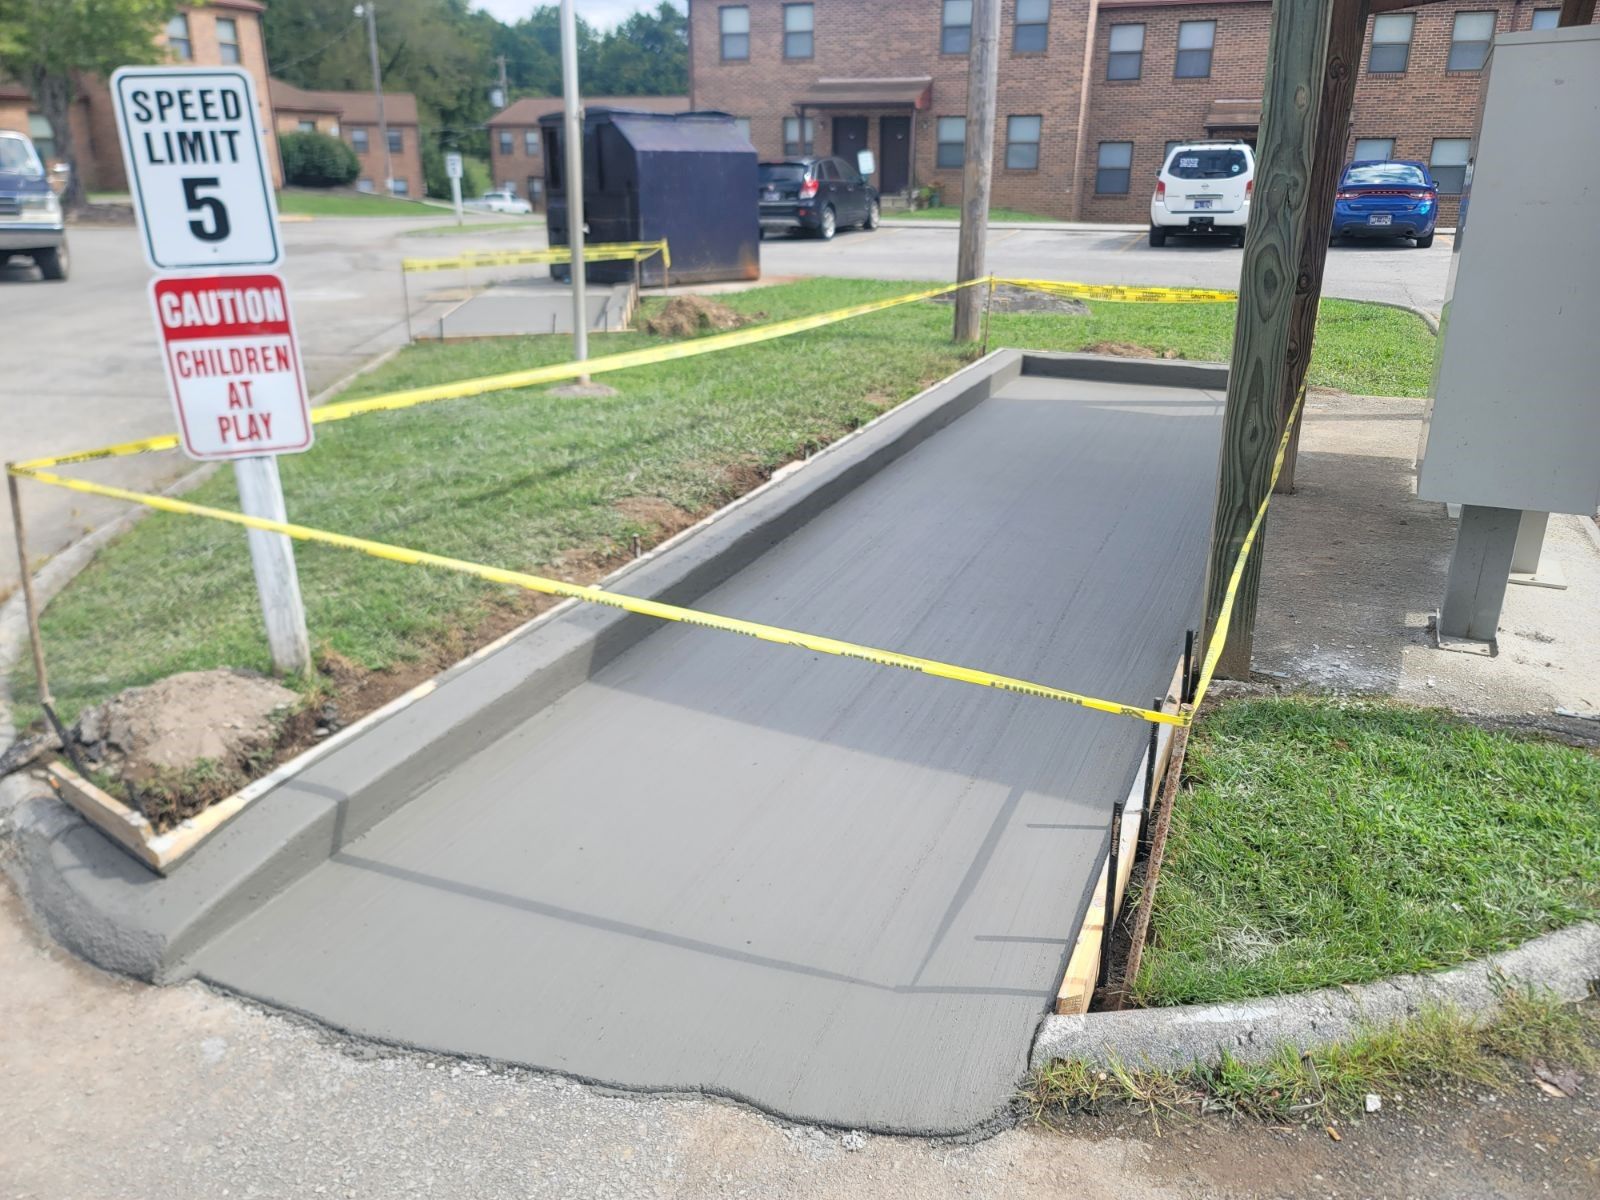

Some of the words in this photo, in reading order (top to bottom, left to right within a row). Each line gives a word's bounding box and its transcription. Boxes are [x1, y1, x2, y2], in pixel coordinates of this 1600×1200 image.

[132, 88, 242, 122] SPEED
[144, 130, 240, 164] LIMIT
[181, 177, 231, 243] 5
[160, 288, 285, 327] CAUTION
[176, 345, 291, 378] CHILDREN
[228, 381, 253, 408] AT
[219, 413, 273, 443] PLAY
